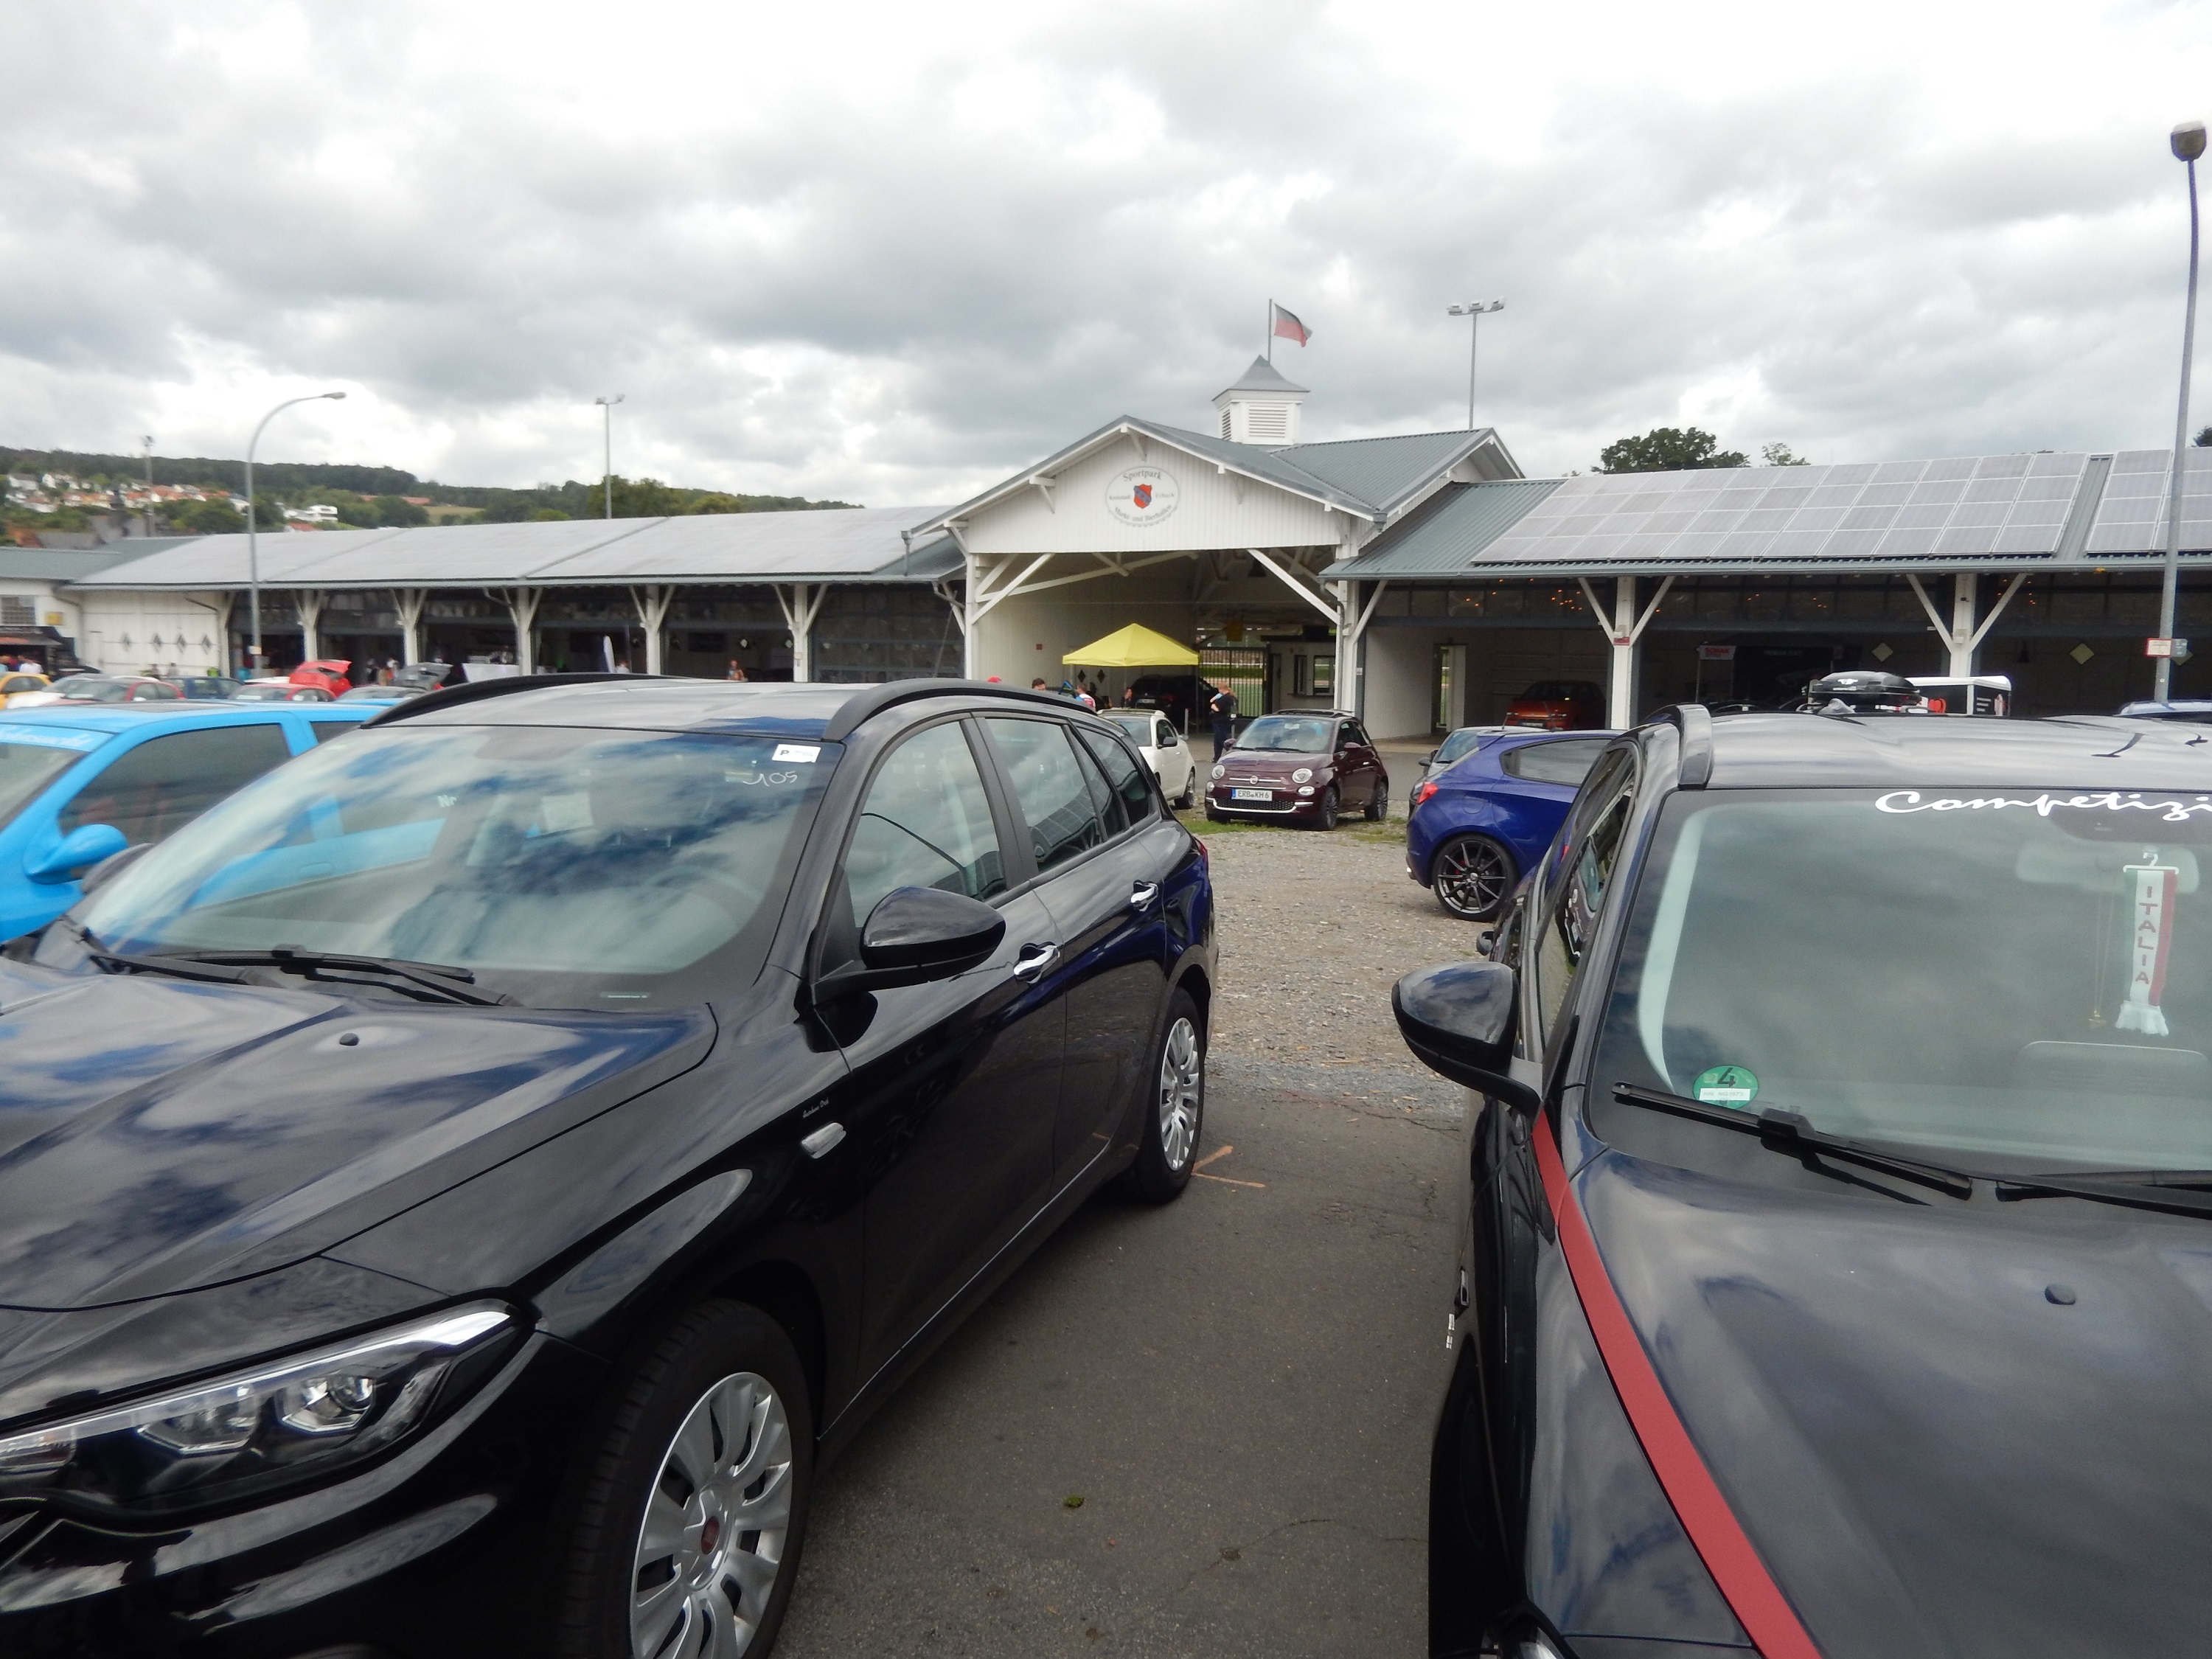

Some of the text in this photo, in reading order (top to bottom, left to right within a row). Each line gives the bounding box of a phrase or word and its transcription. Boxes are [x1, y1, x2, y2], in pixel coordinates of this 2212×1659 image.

[1123, 470, 1161, 481] Sportpark
[2135, 886, 2158, 984] ITALIA
[1717, 1067, 1736, 1088] 4
